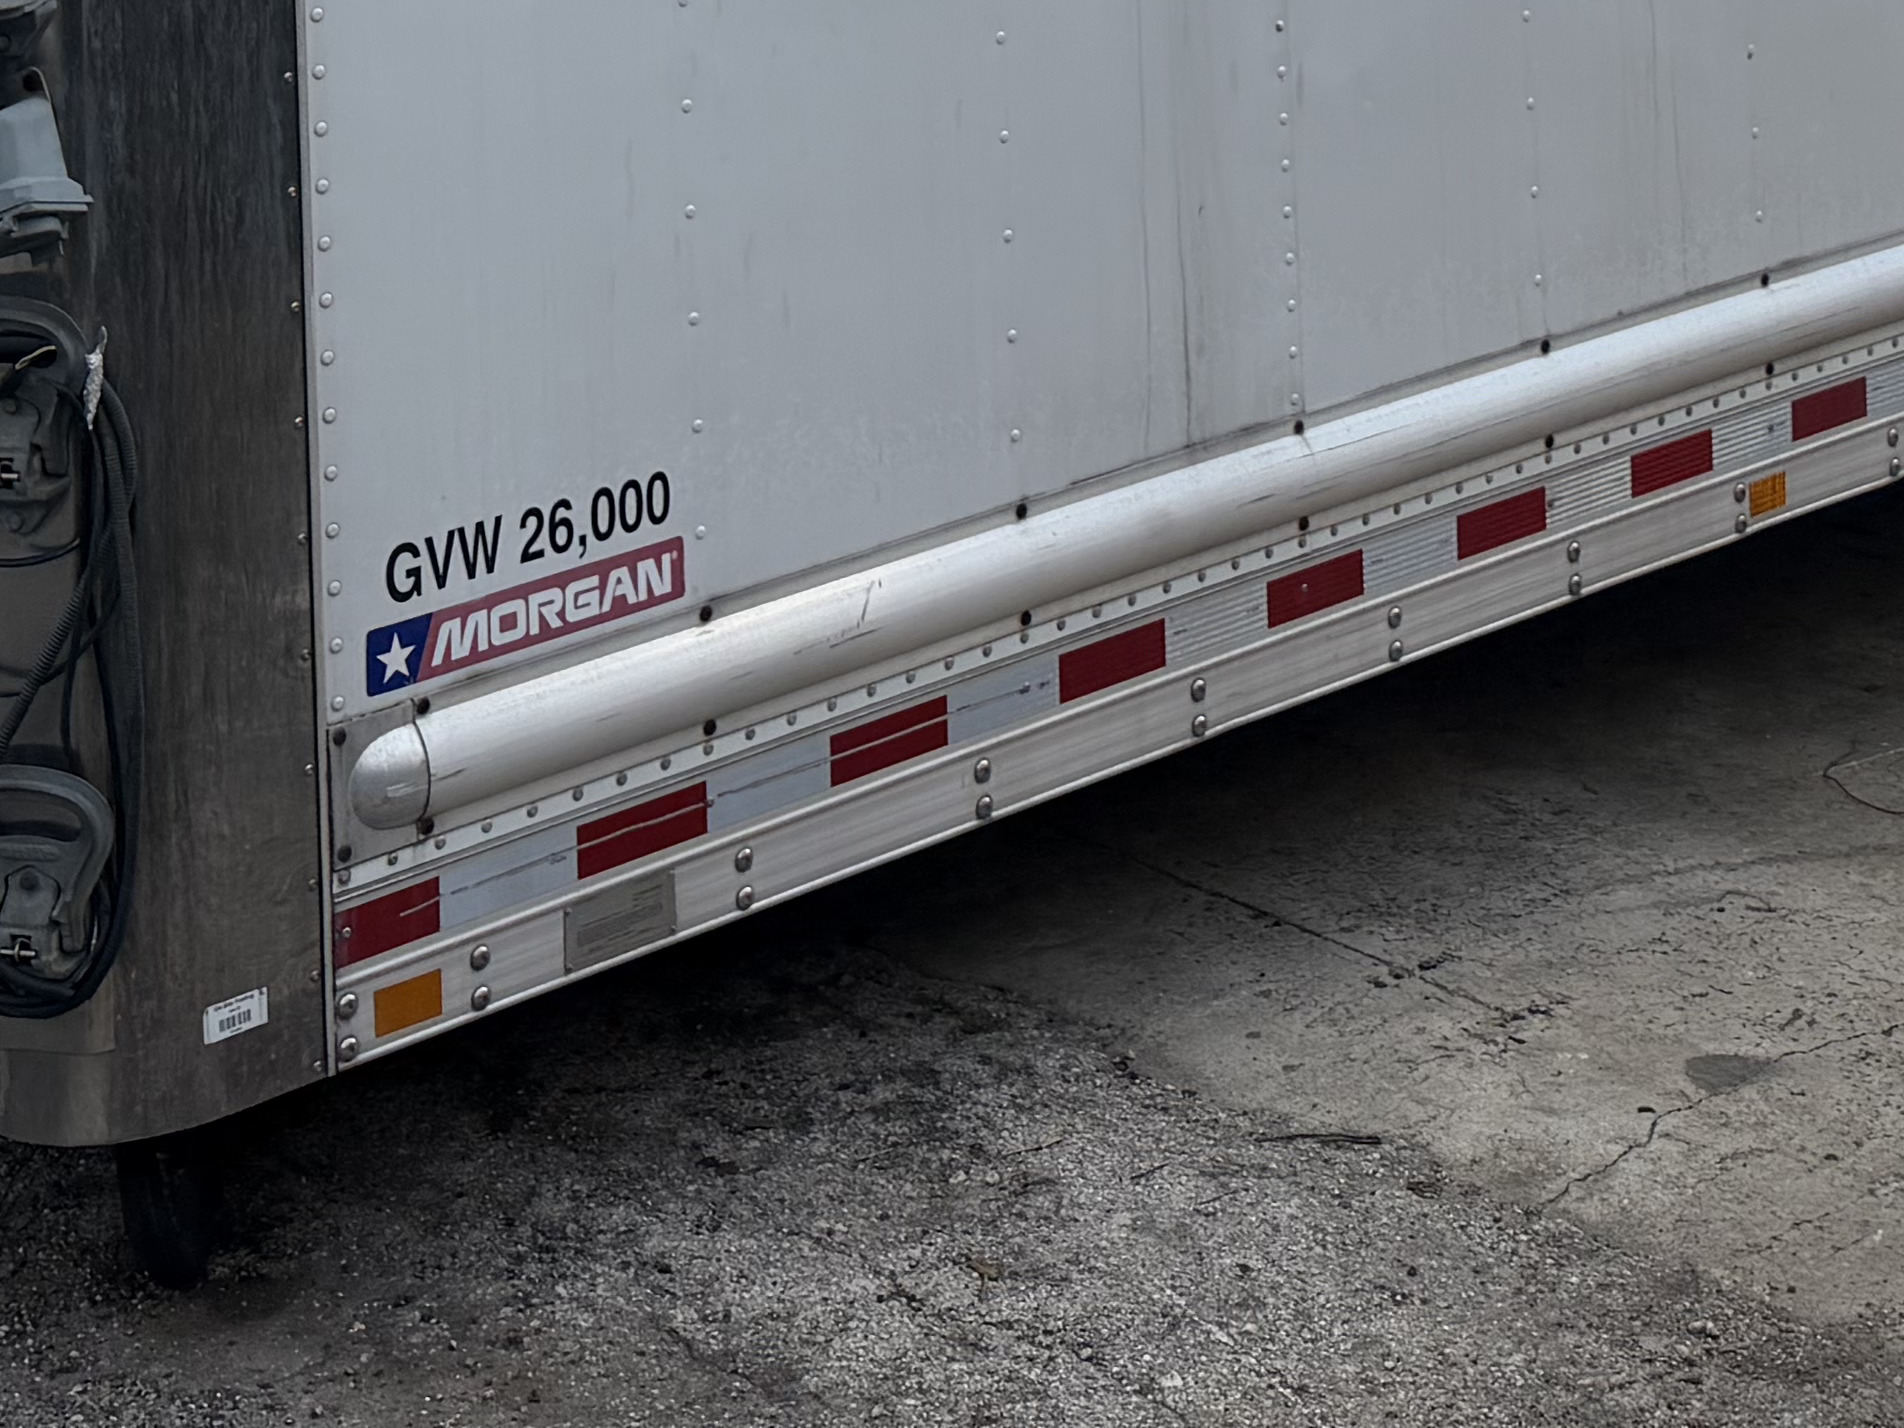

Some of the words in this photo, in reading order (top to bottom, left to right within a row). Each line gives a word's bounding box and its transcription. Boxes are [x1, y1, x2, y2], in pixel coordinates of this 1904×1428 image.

[385, 514, 503, 603] GVW
[519, 471, 671, 564] 26,000
[431, 550, 674, 668] MORGAN
